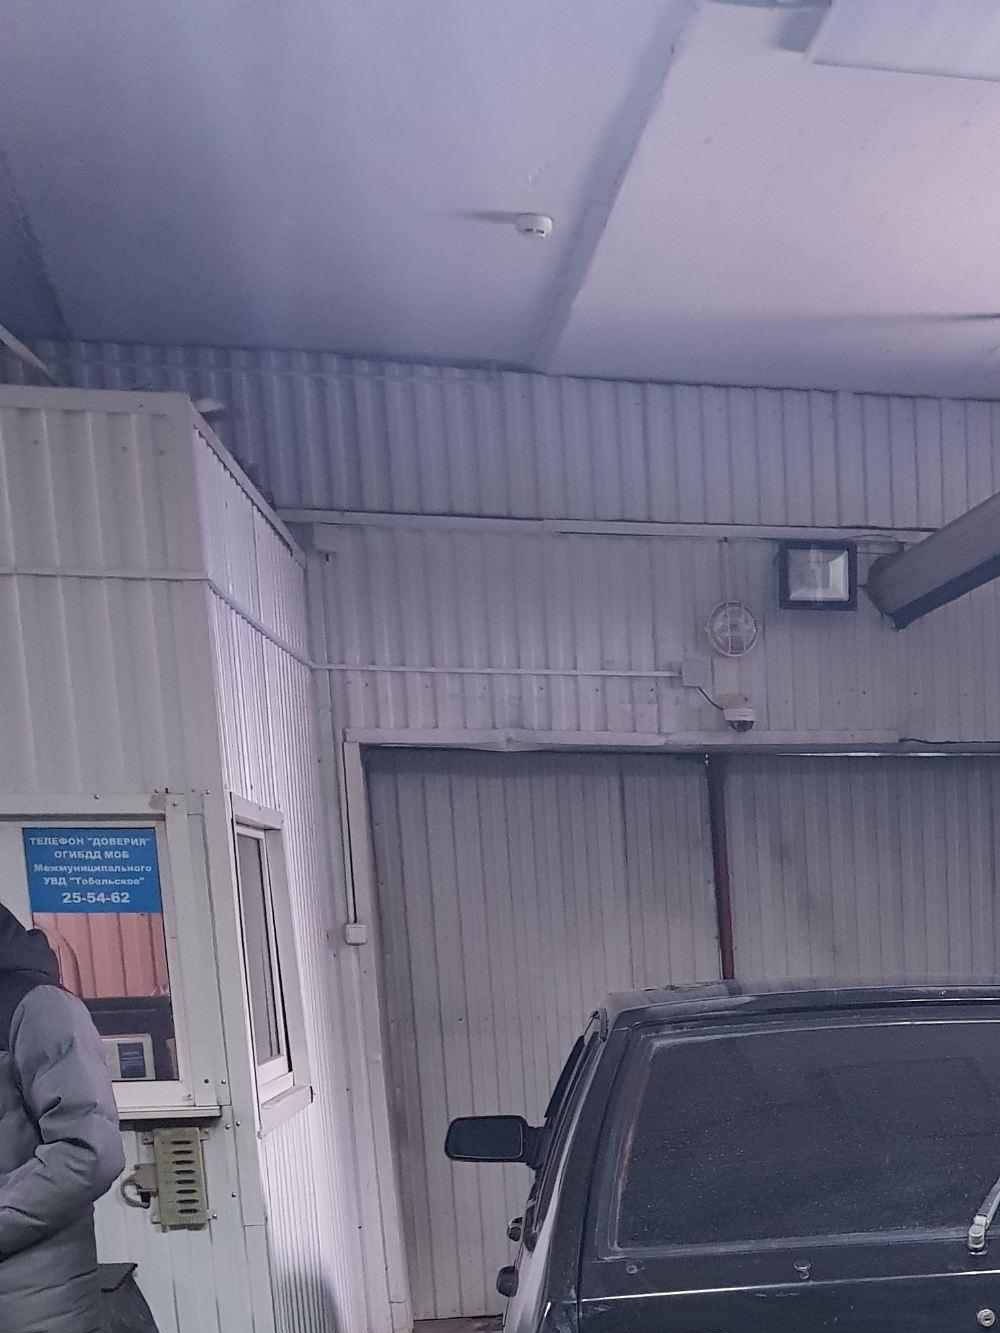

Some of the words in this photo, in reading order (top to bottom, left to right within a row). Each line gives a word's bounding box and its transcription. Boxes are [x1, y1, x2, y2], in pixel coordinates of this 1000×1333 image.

[29, 837, 84, 846] ТЕЛЕФОН
[54, 850, 101, 860] ОГИБДД
[104, 850, 130, 859] МОБ
[33, 863, 152, 874] Межмуниципального
[43, 877, 67, 887] УВД
[61, 892, 131, 904] 25-54-62
